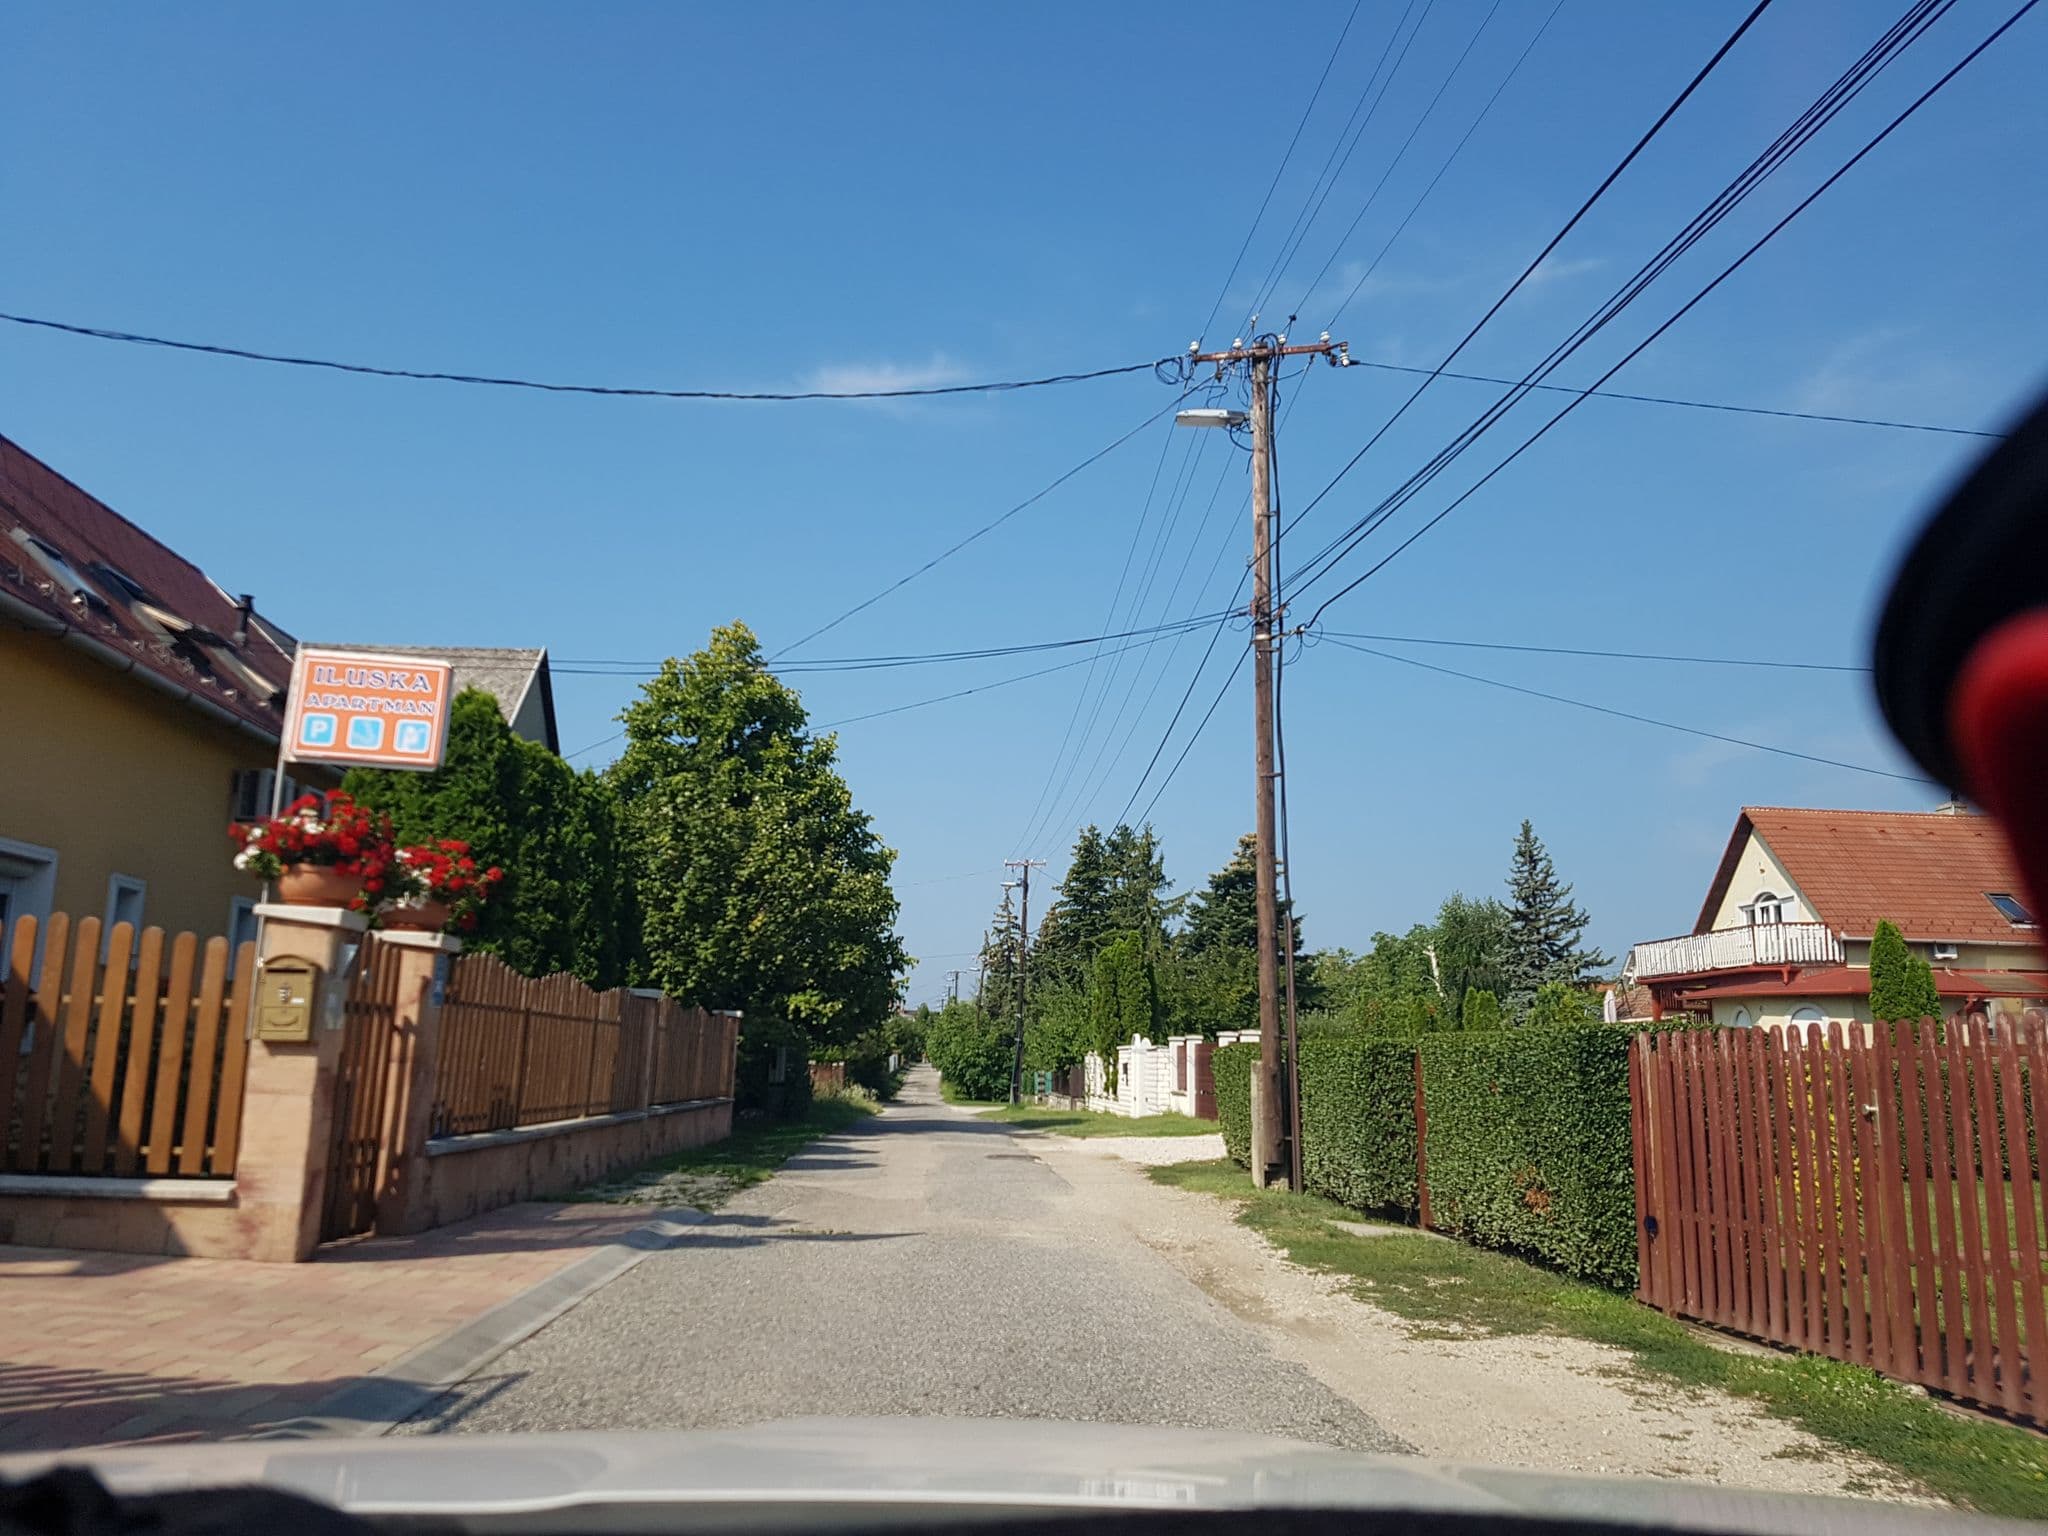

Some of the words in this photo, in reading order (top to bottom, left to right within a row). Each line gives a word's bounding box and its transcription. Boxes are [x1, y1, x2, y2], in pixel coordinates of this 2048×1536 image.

[314, 666, 432, 693] ILUSKA
[306, 693, 435, 716] APARTMAN
[310, 720, 328, 739] P
